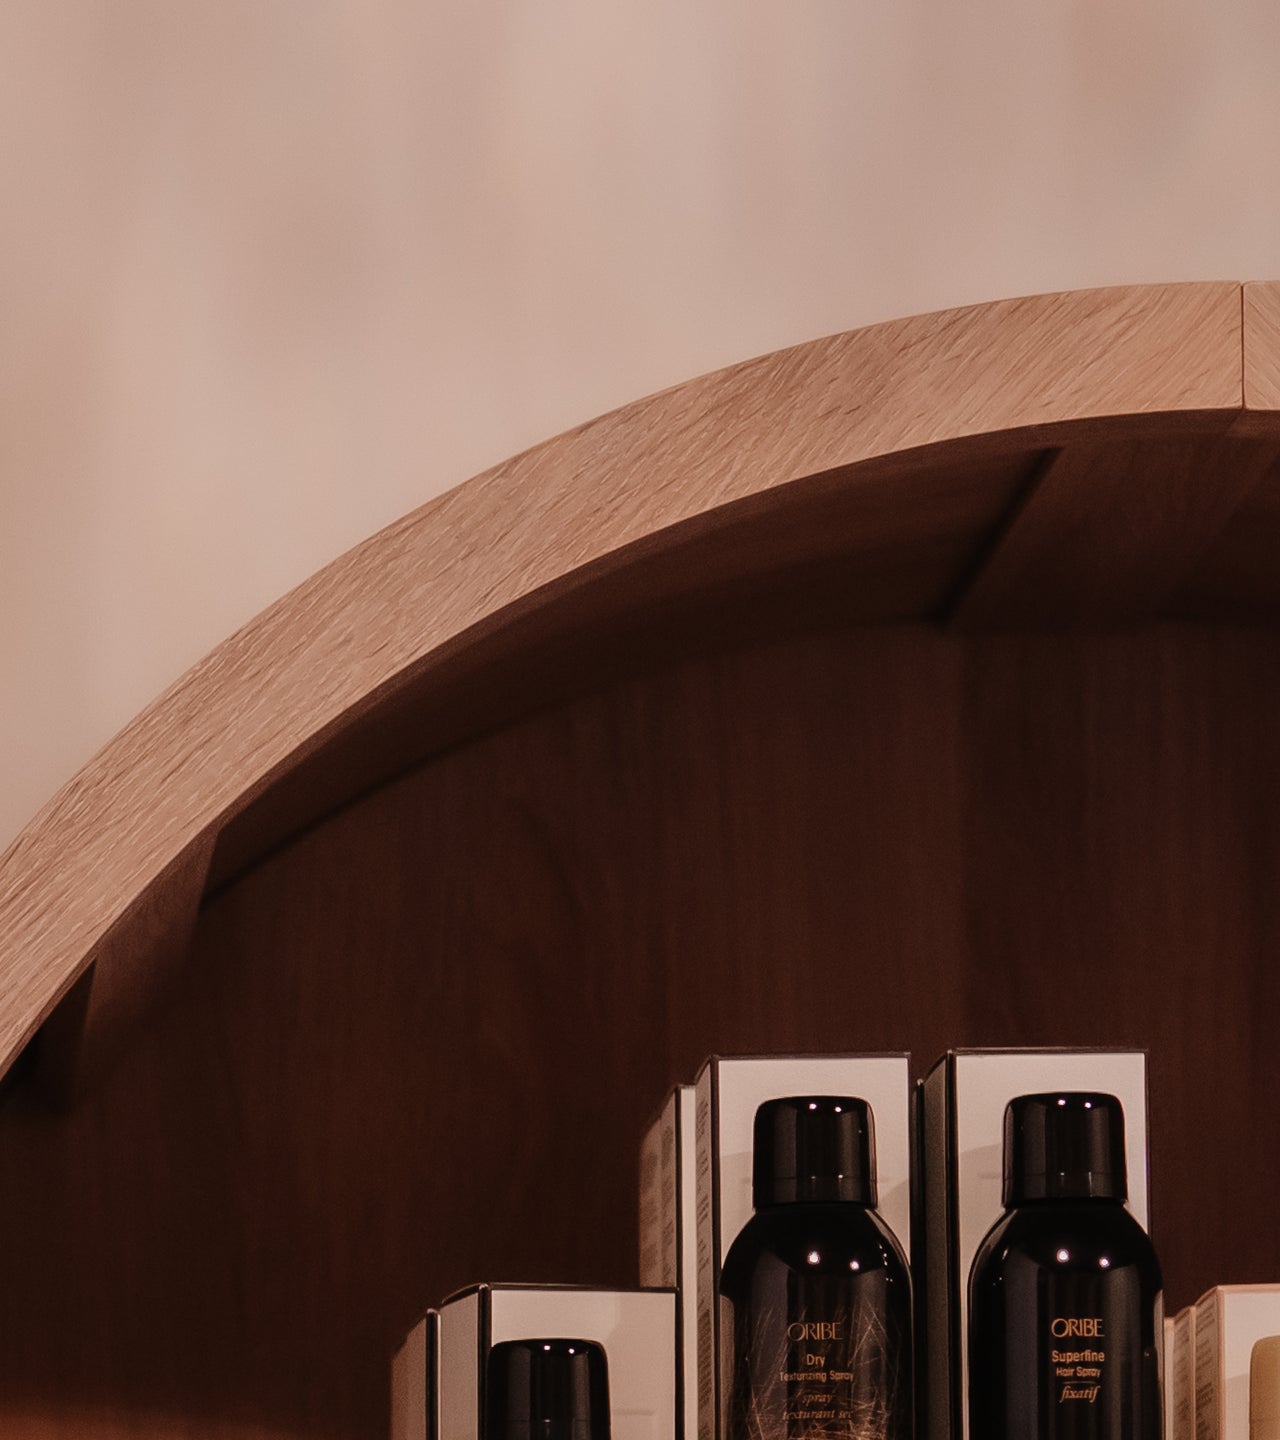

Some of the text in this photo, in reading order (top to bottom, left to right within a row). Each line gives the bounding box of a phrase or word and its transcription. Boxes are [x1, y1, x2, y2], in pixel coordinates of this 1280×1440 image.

[787, 1322, 844, 1341] ORIBE
[1051, 1318, 1106, 1338] ORIBE
[806, 1353, 826, 1367] Dry
[1051, 1348, 1106, 1364] Superfine
[1056, 1366, 1101, 1378] Hair Spray
[1059, 1385, 1102, 1403] fixatif
